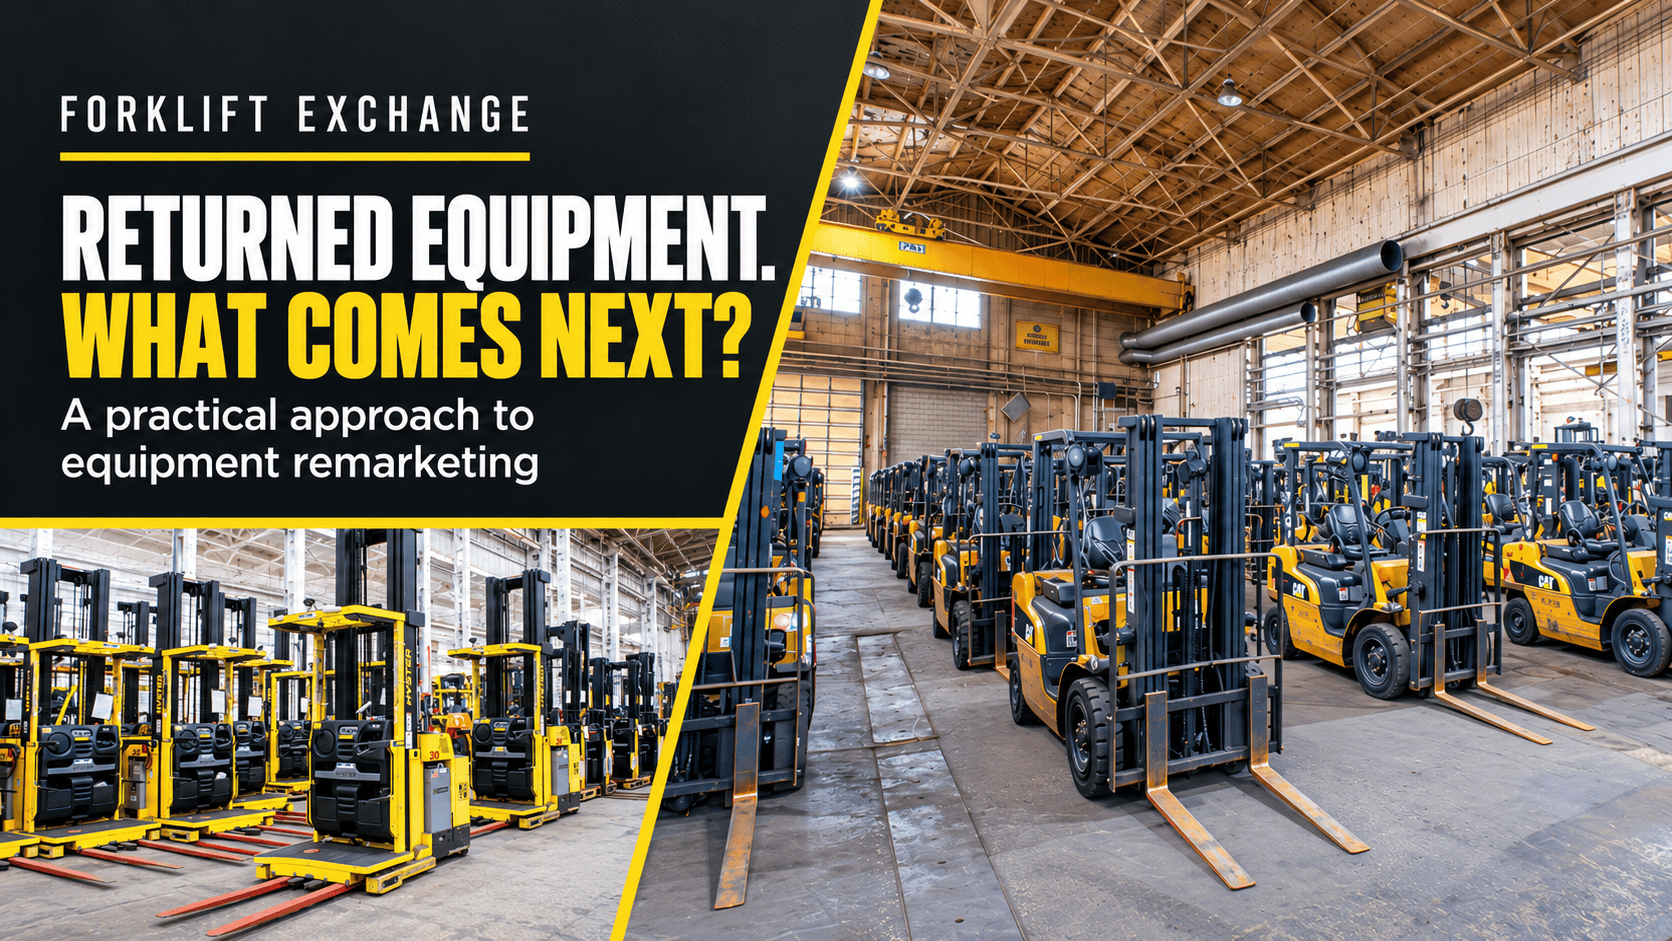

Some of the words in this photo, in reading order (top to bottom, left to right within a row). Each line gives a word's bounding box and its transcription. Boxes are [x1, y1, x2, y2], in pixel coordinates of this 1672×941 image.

[1538, 574, 1555, 590] CAT
[1292, 582, 1306, 599] CAT
[405, 648, 413, 706] HYSTER
[429, 750, 440, 760] 30
